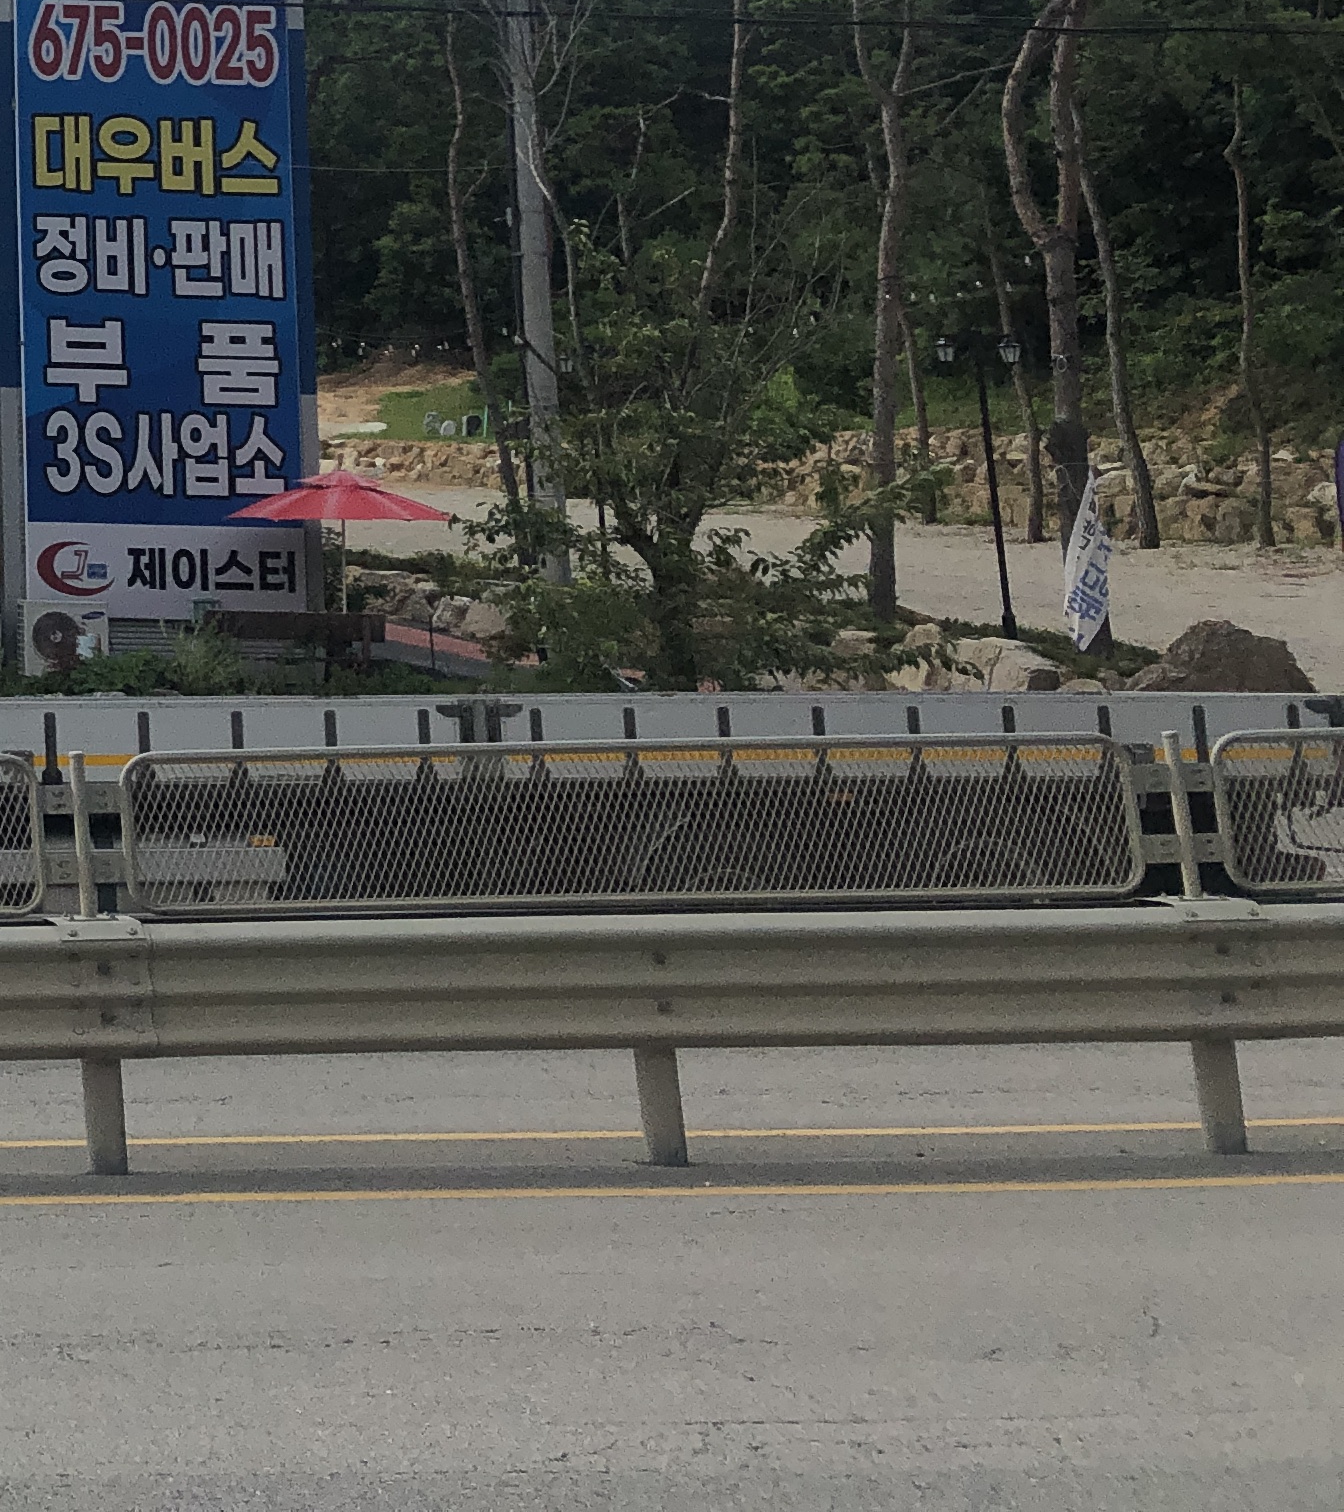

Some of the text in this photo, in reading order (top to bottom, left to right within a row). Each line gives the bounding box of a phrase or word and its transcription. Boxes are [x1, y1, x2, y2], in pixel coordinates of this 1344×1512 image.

[29, 1, 279, 86] 675-0025
[32, 114, 280, 196] 대우버스
[46, 410, 286, 497] 3S사업소
[127, 548, 296, 594] 제이스터
